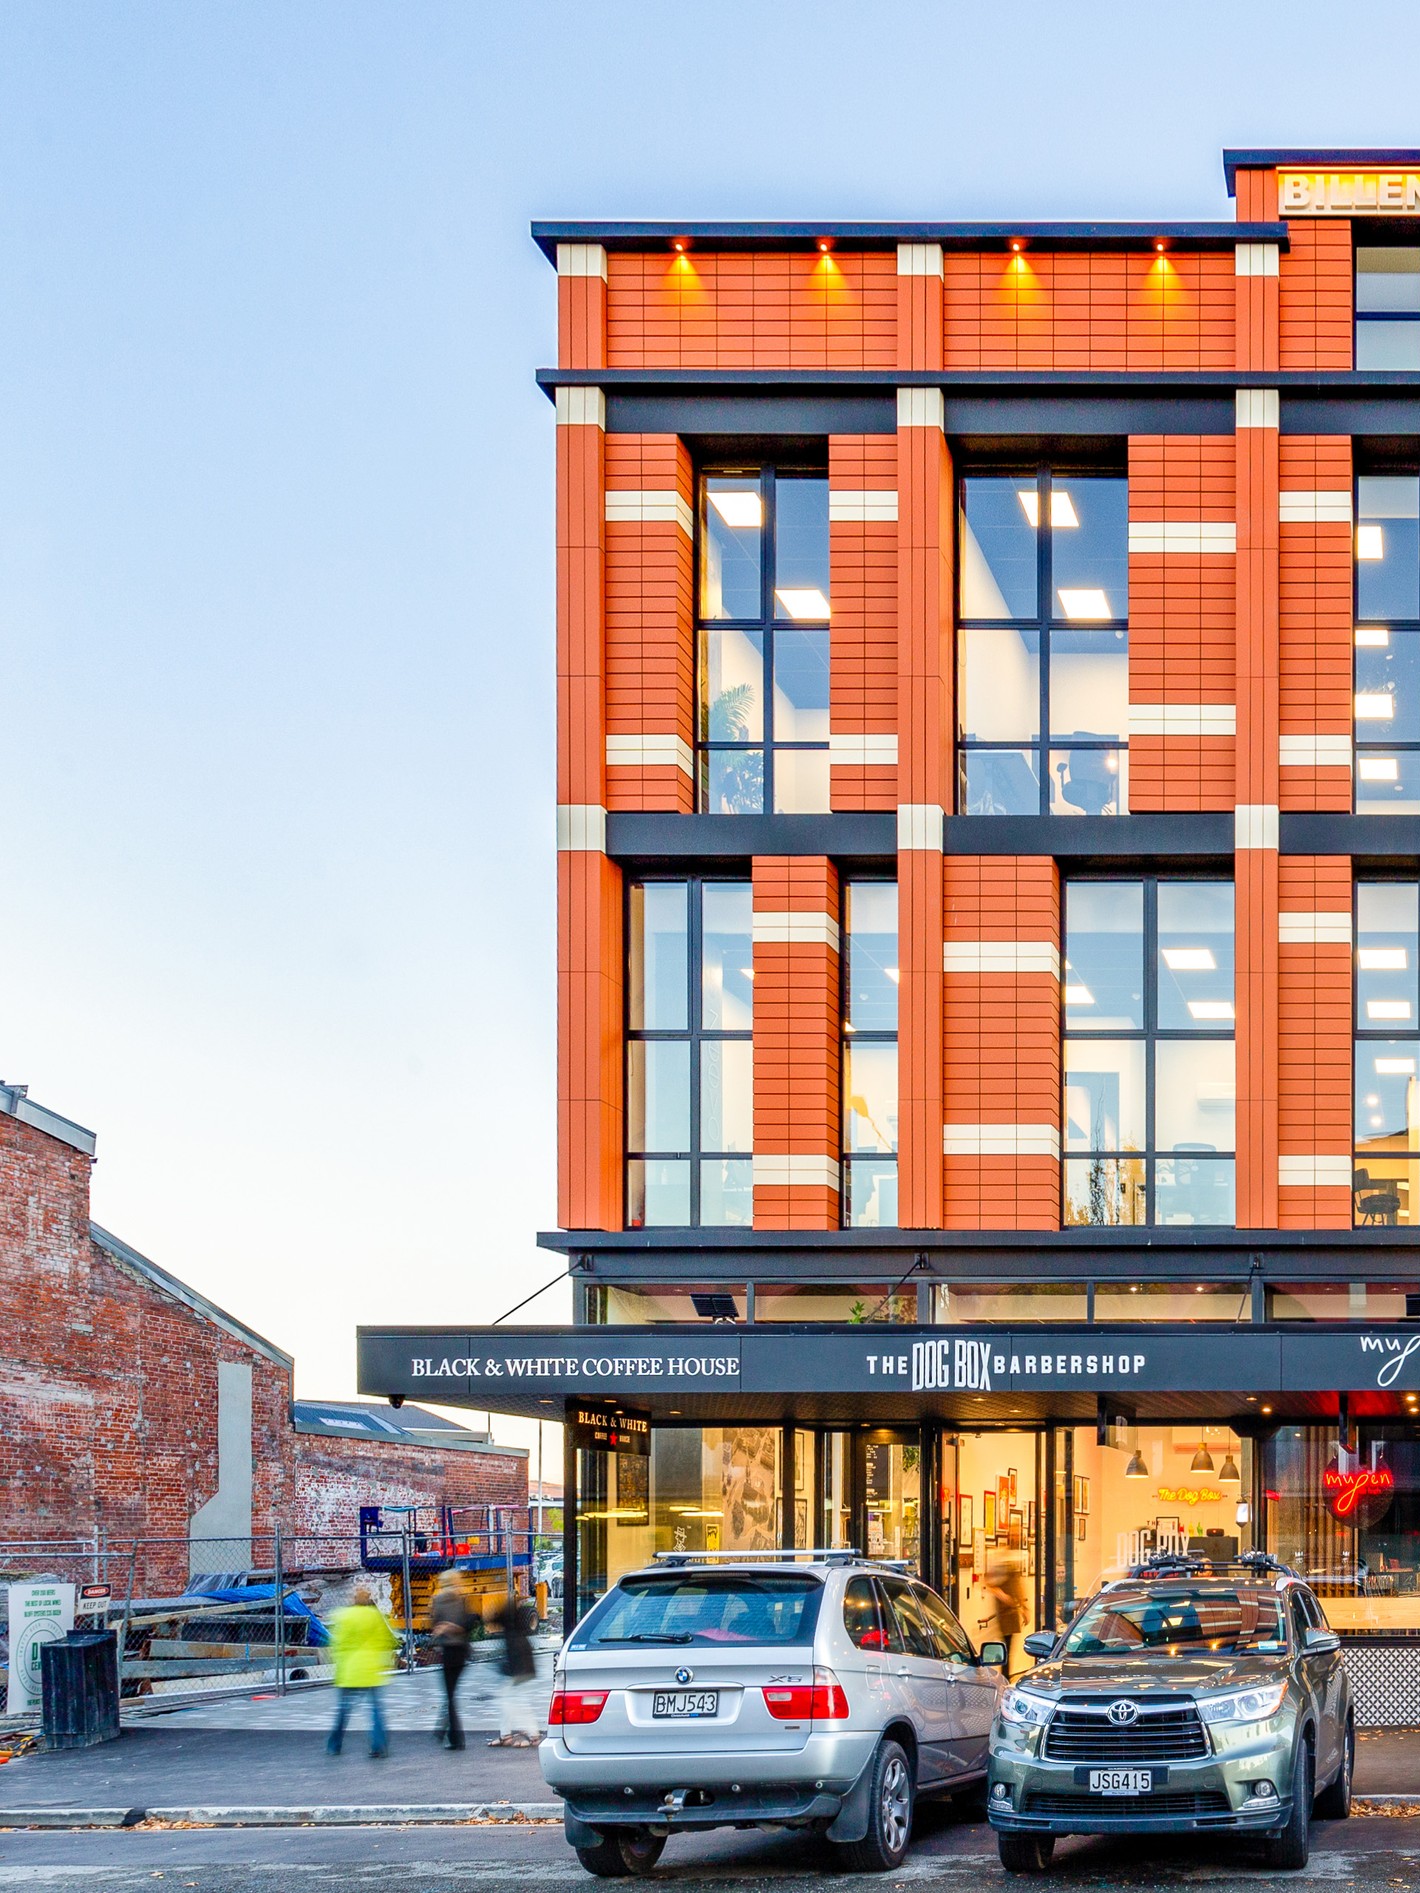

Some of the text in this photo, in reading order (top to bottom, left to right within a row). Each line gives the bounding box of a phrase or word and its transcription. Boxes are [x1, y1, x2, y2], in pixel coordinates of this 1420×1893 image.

[411, 1357, 741, 1377] BLACK & WHITE COFFEE HOUSE
[866, 1339, 1147, 1392] THE DOG BOX BARBERSHOP
[578, 1411, 648, 1433] BLACK & WHITE
[1157, 1487, 1222, 1506] The Dog Box
[83, 1600, 107, 1610] KEEP OUT
[768, 1674, 803, 1683] X5
[656, 1694, 716, 1713] BMJ543
[1092, 1773, 1150, 1790] JSG415
